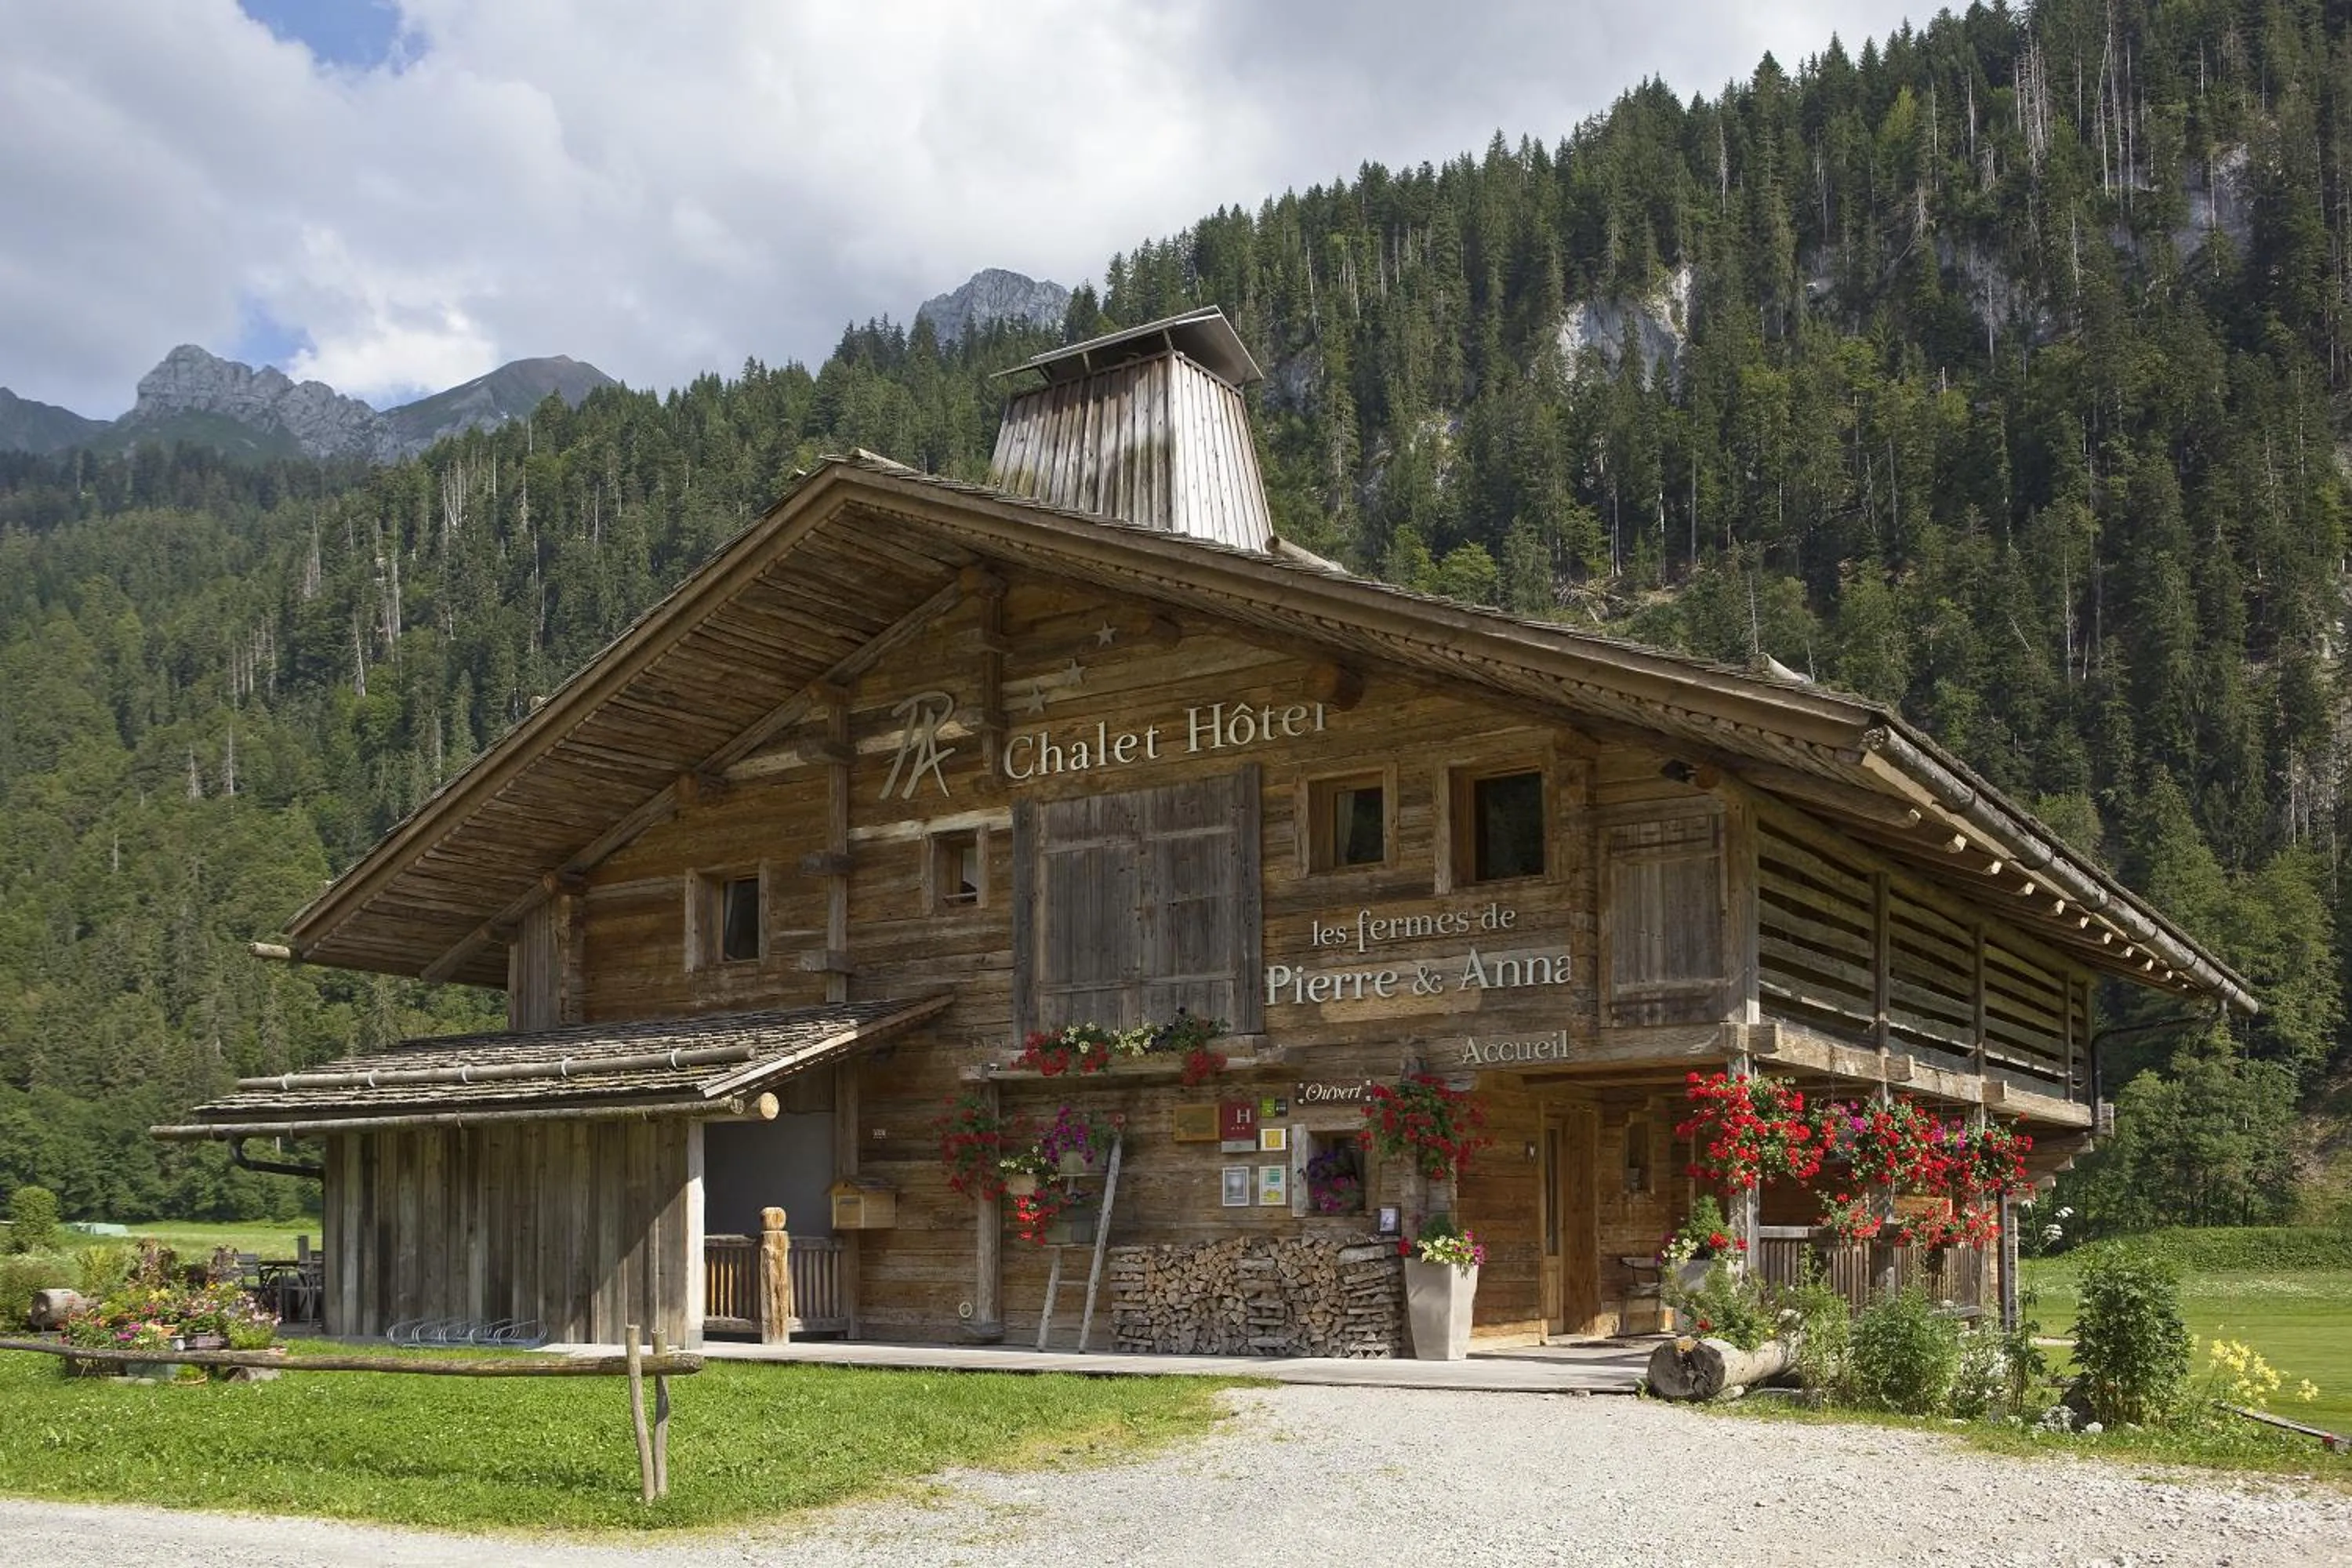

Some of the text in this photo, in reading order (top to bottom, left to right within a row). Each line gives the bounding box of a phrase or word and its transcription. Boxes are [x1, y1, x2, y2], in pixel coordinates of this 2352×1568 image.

[1004, 702, 1325, 779] Chalet Hôtel
[1312, 903, 1516, 953] les fermes de
[1265, 948, 1571, 1006] Pierre & Anna
[1462, 1030, 1568, 1065] Accueil
[1305, 1083, 1362, 1101] Ouvert
[1236, 1108, 1250, 1123] H
